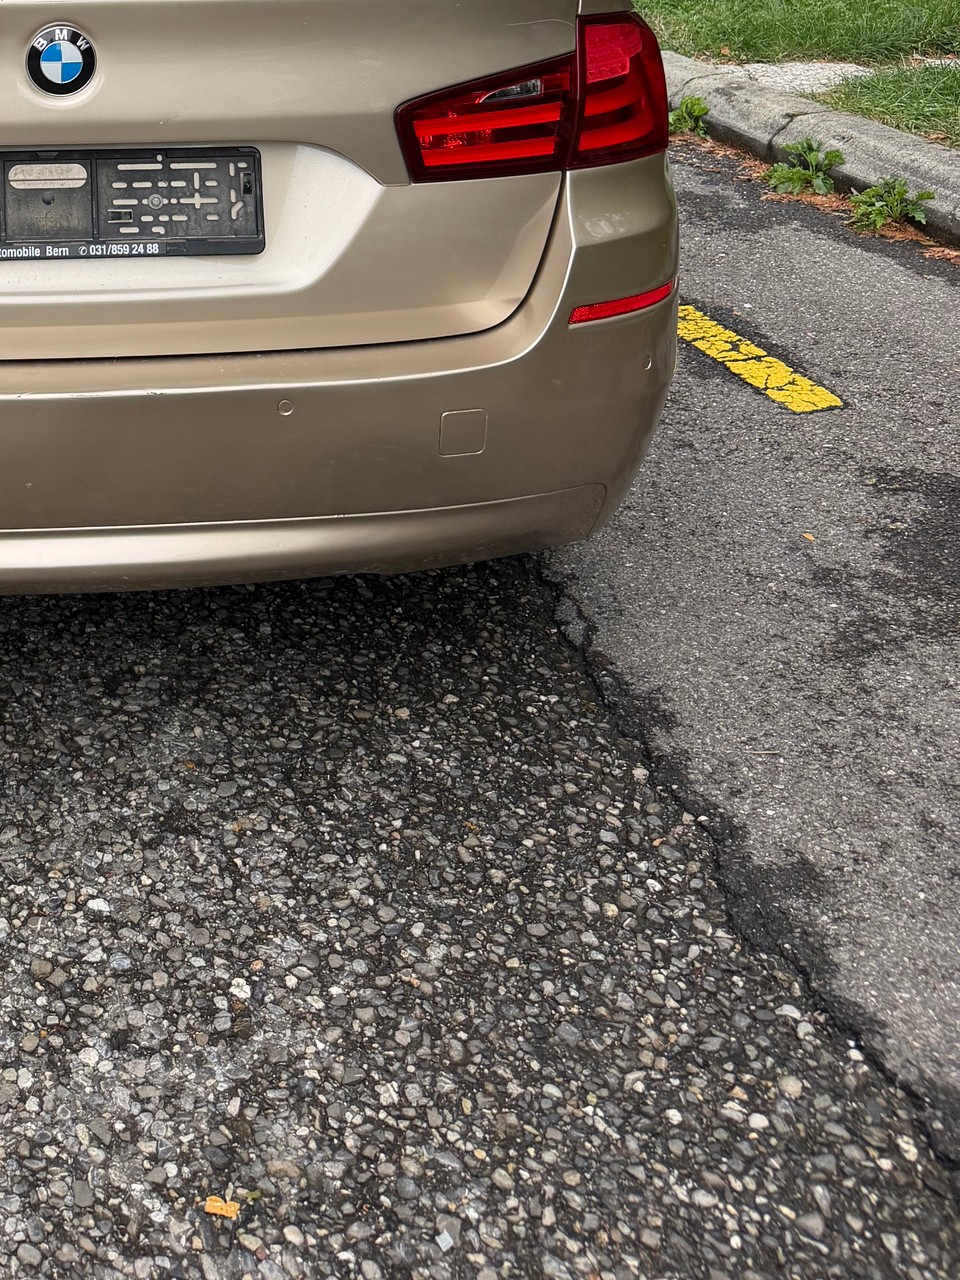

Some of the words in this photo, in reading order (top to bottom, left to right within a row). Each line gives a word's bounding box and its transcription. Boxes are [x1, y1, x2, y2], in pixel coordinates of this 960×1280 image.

[33, 28, 90, 52] BMW
[46, 245, 69, 256] Bern
[89, 244, 130, 256] 031/859
[131, 243, 145, 254] 24
[146, 243, 159, 254] 88
